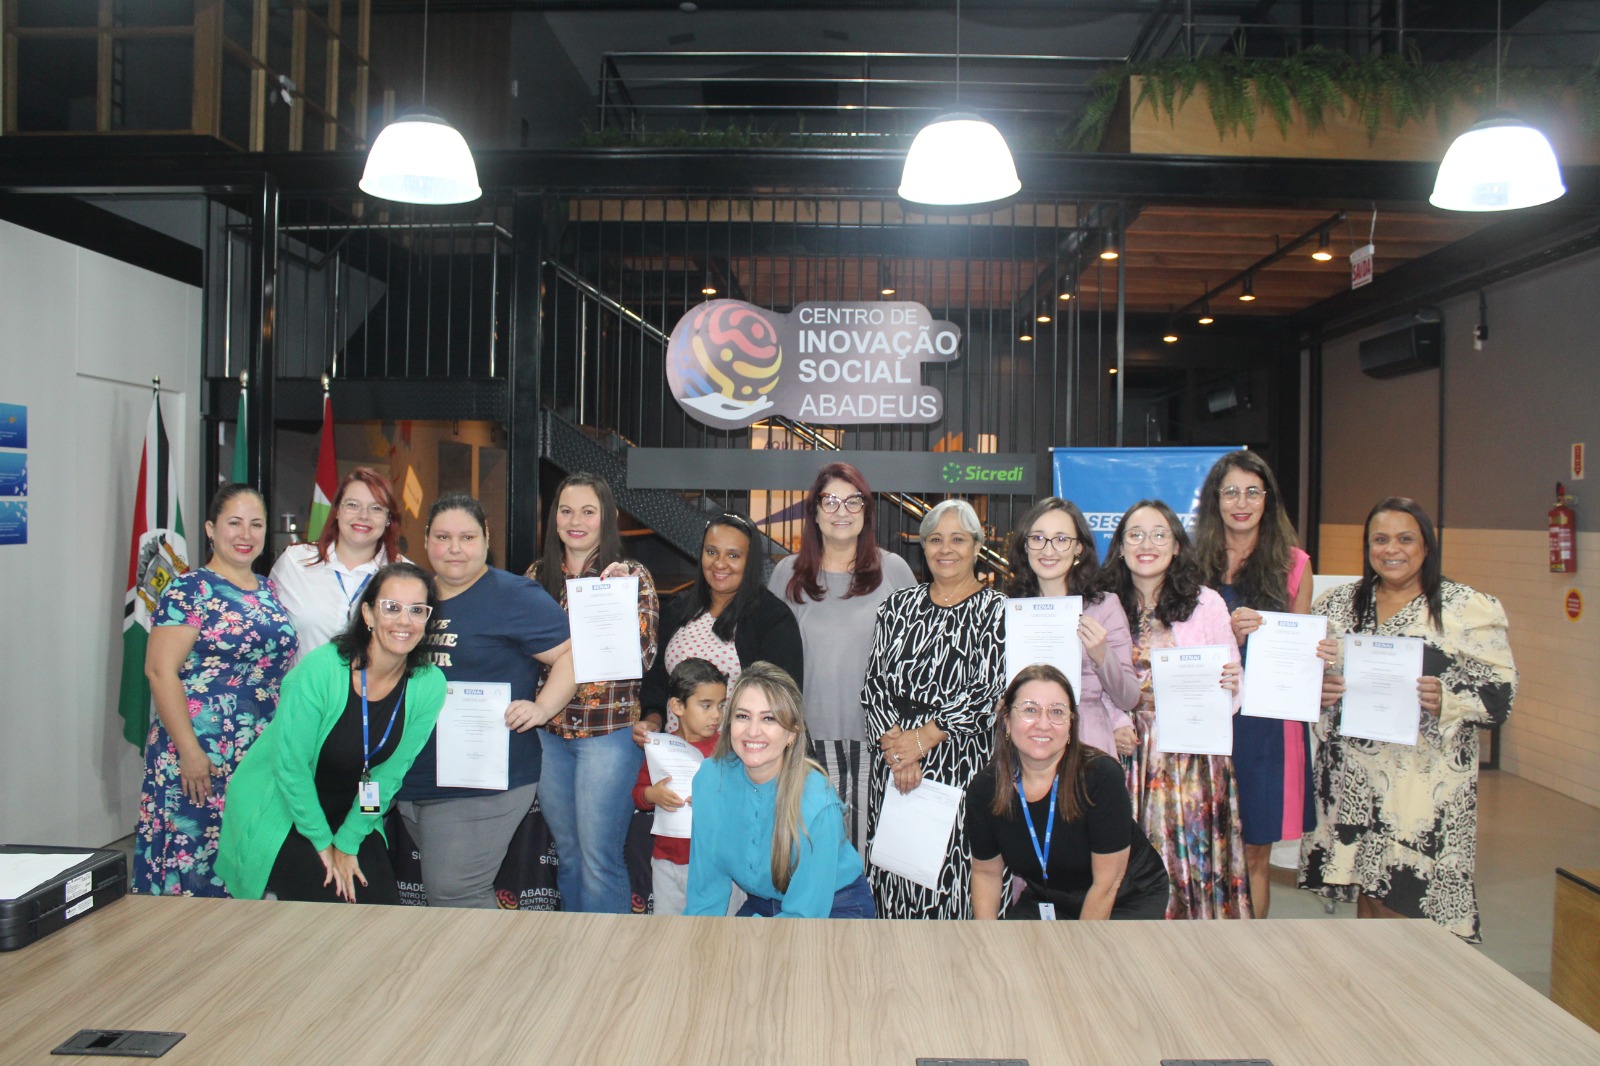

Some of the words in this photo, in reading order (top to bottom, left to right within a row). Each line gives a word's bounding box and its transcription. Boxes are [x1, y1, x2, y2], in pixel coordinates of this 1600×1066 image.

[799, 308, 884, 325] CENTRO
[891, 309, 918, 325] DE
[799, 326, 958, 359] INOVAÇÃO
[798, 359, 912, 383] SOCIAL
[799, 394, 937, 417] ABADEUS
[965, 466, 1024, 481] Sicredi
[1088, 515, 1121, 529] SES
